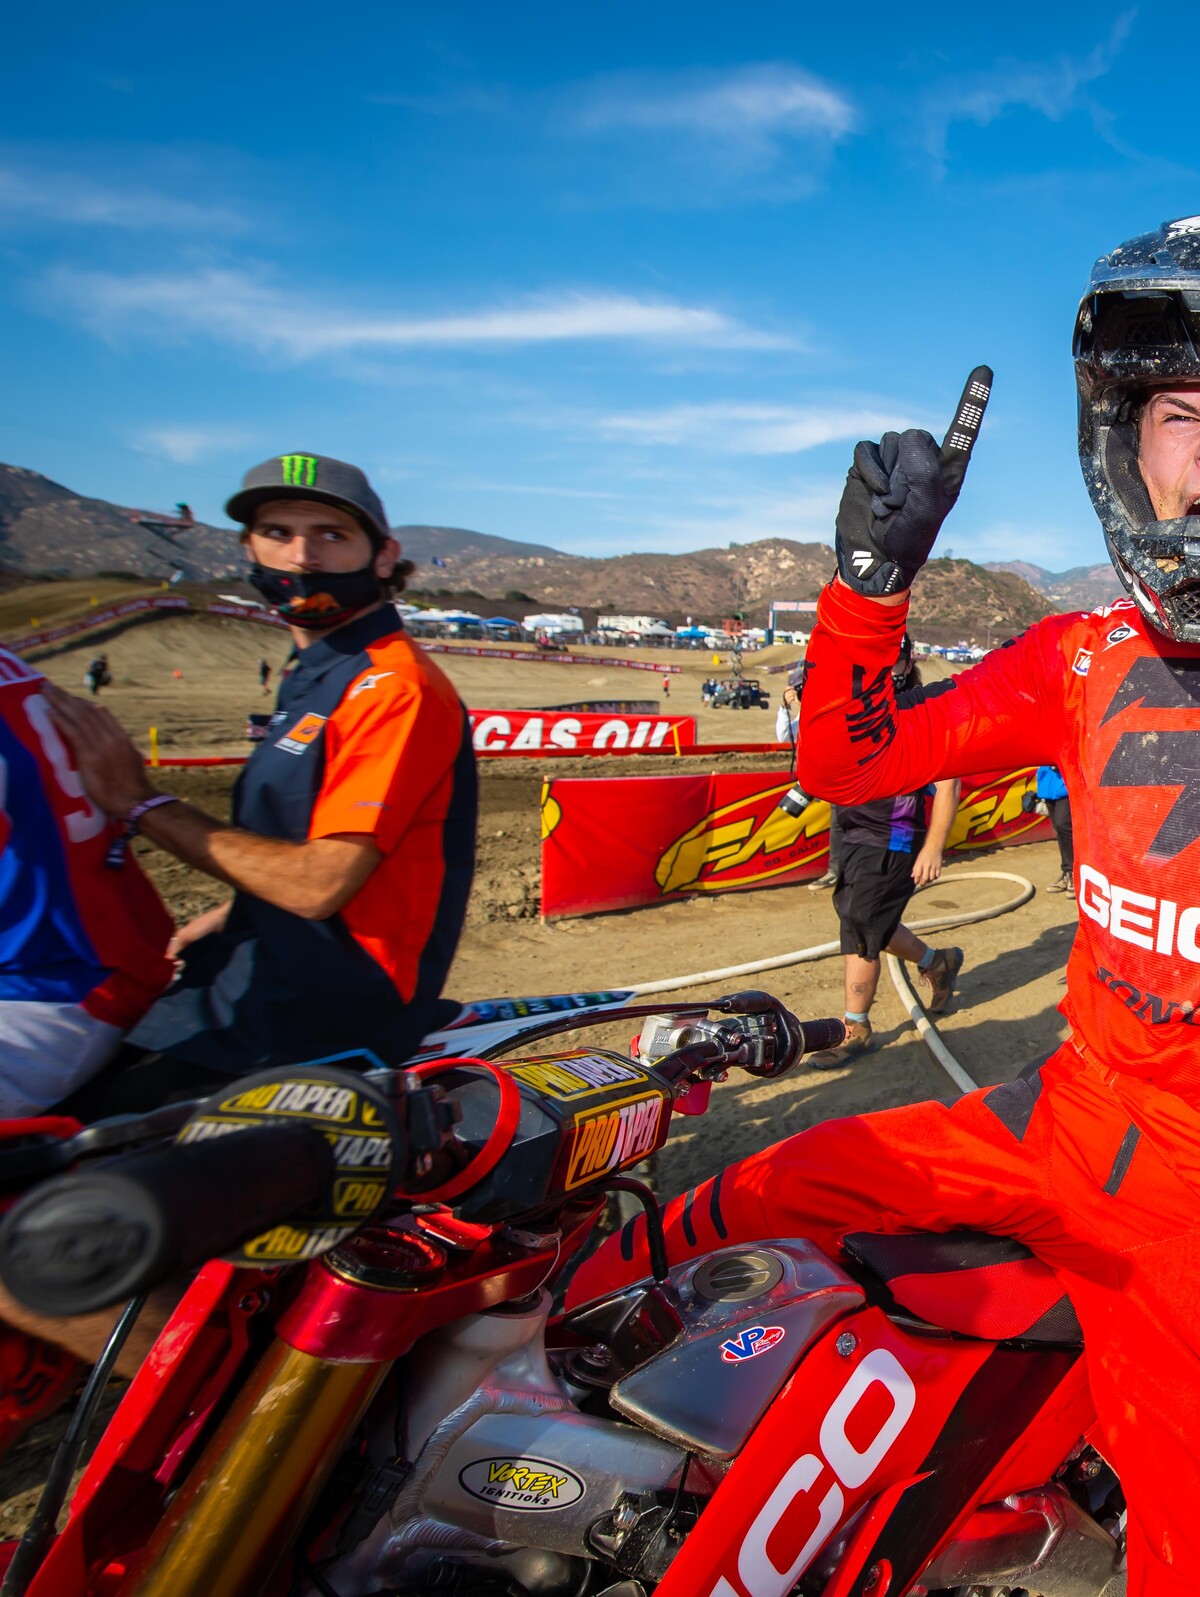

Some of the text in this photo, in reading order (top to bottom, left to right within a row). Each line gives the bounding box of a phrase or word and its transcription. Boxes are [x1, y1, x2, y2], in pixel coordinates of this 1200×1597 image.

[469, 715, 583, 750] CAS
[661, 797, 831, 897] FM
[512, 1055, 643, 1094] PROTAPER
[579, 1097, 661, 1177] PROTAPER
[720, 1327, 766, 1358] VP
[488, 1461, 568, 1499] VORTEX
[706, 1348, 916, 1597] CO
[480, 1486, 551, 1506] IGNITIONS
